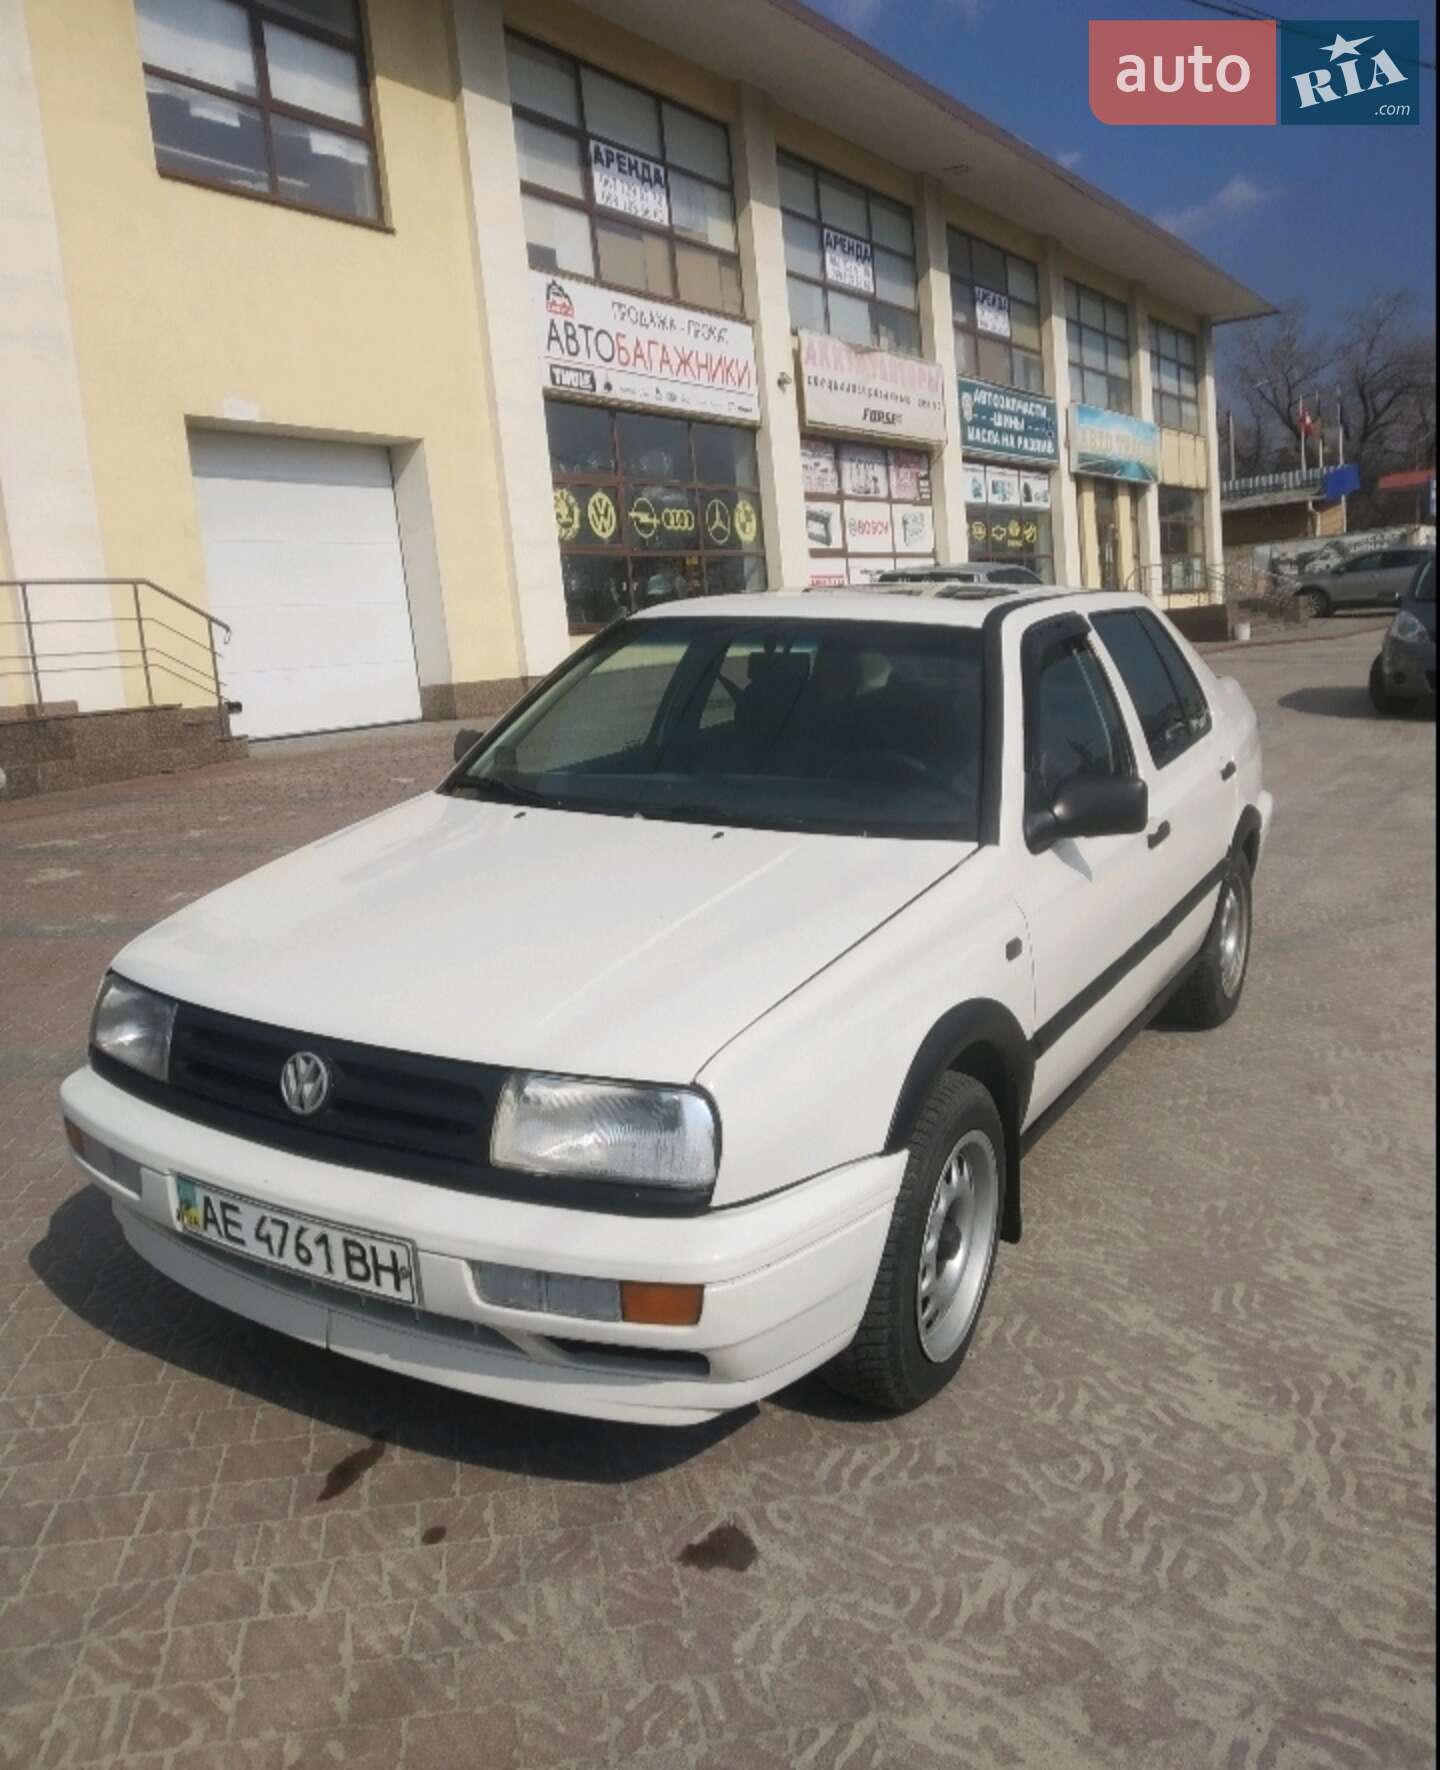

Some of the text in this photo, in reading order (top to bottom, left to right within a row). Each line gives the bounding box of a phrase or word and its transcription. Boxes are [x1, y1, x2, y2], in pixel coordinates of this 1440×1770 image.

[594, 144, 665, 189] АРЕНДА
[825, 231, 872, 264] АРЕНДА
[547, 318, 751, 389] АВТОБАГАЖНИКИ
[203, 1195, 401, 1292] AE 4761 BH
